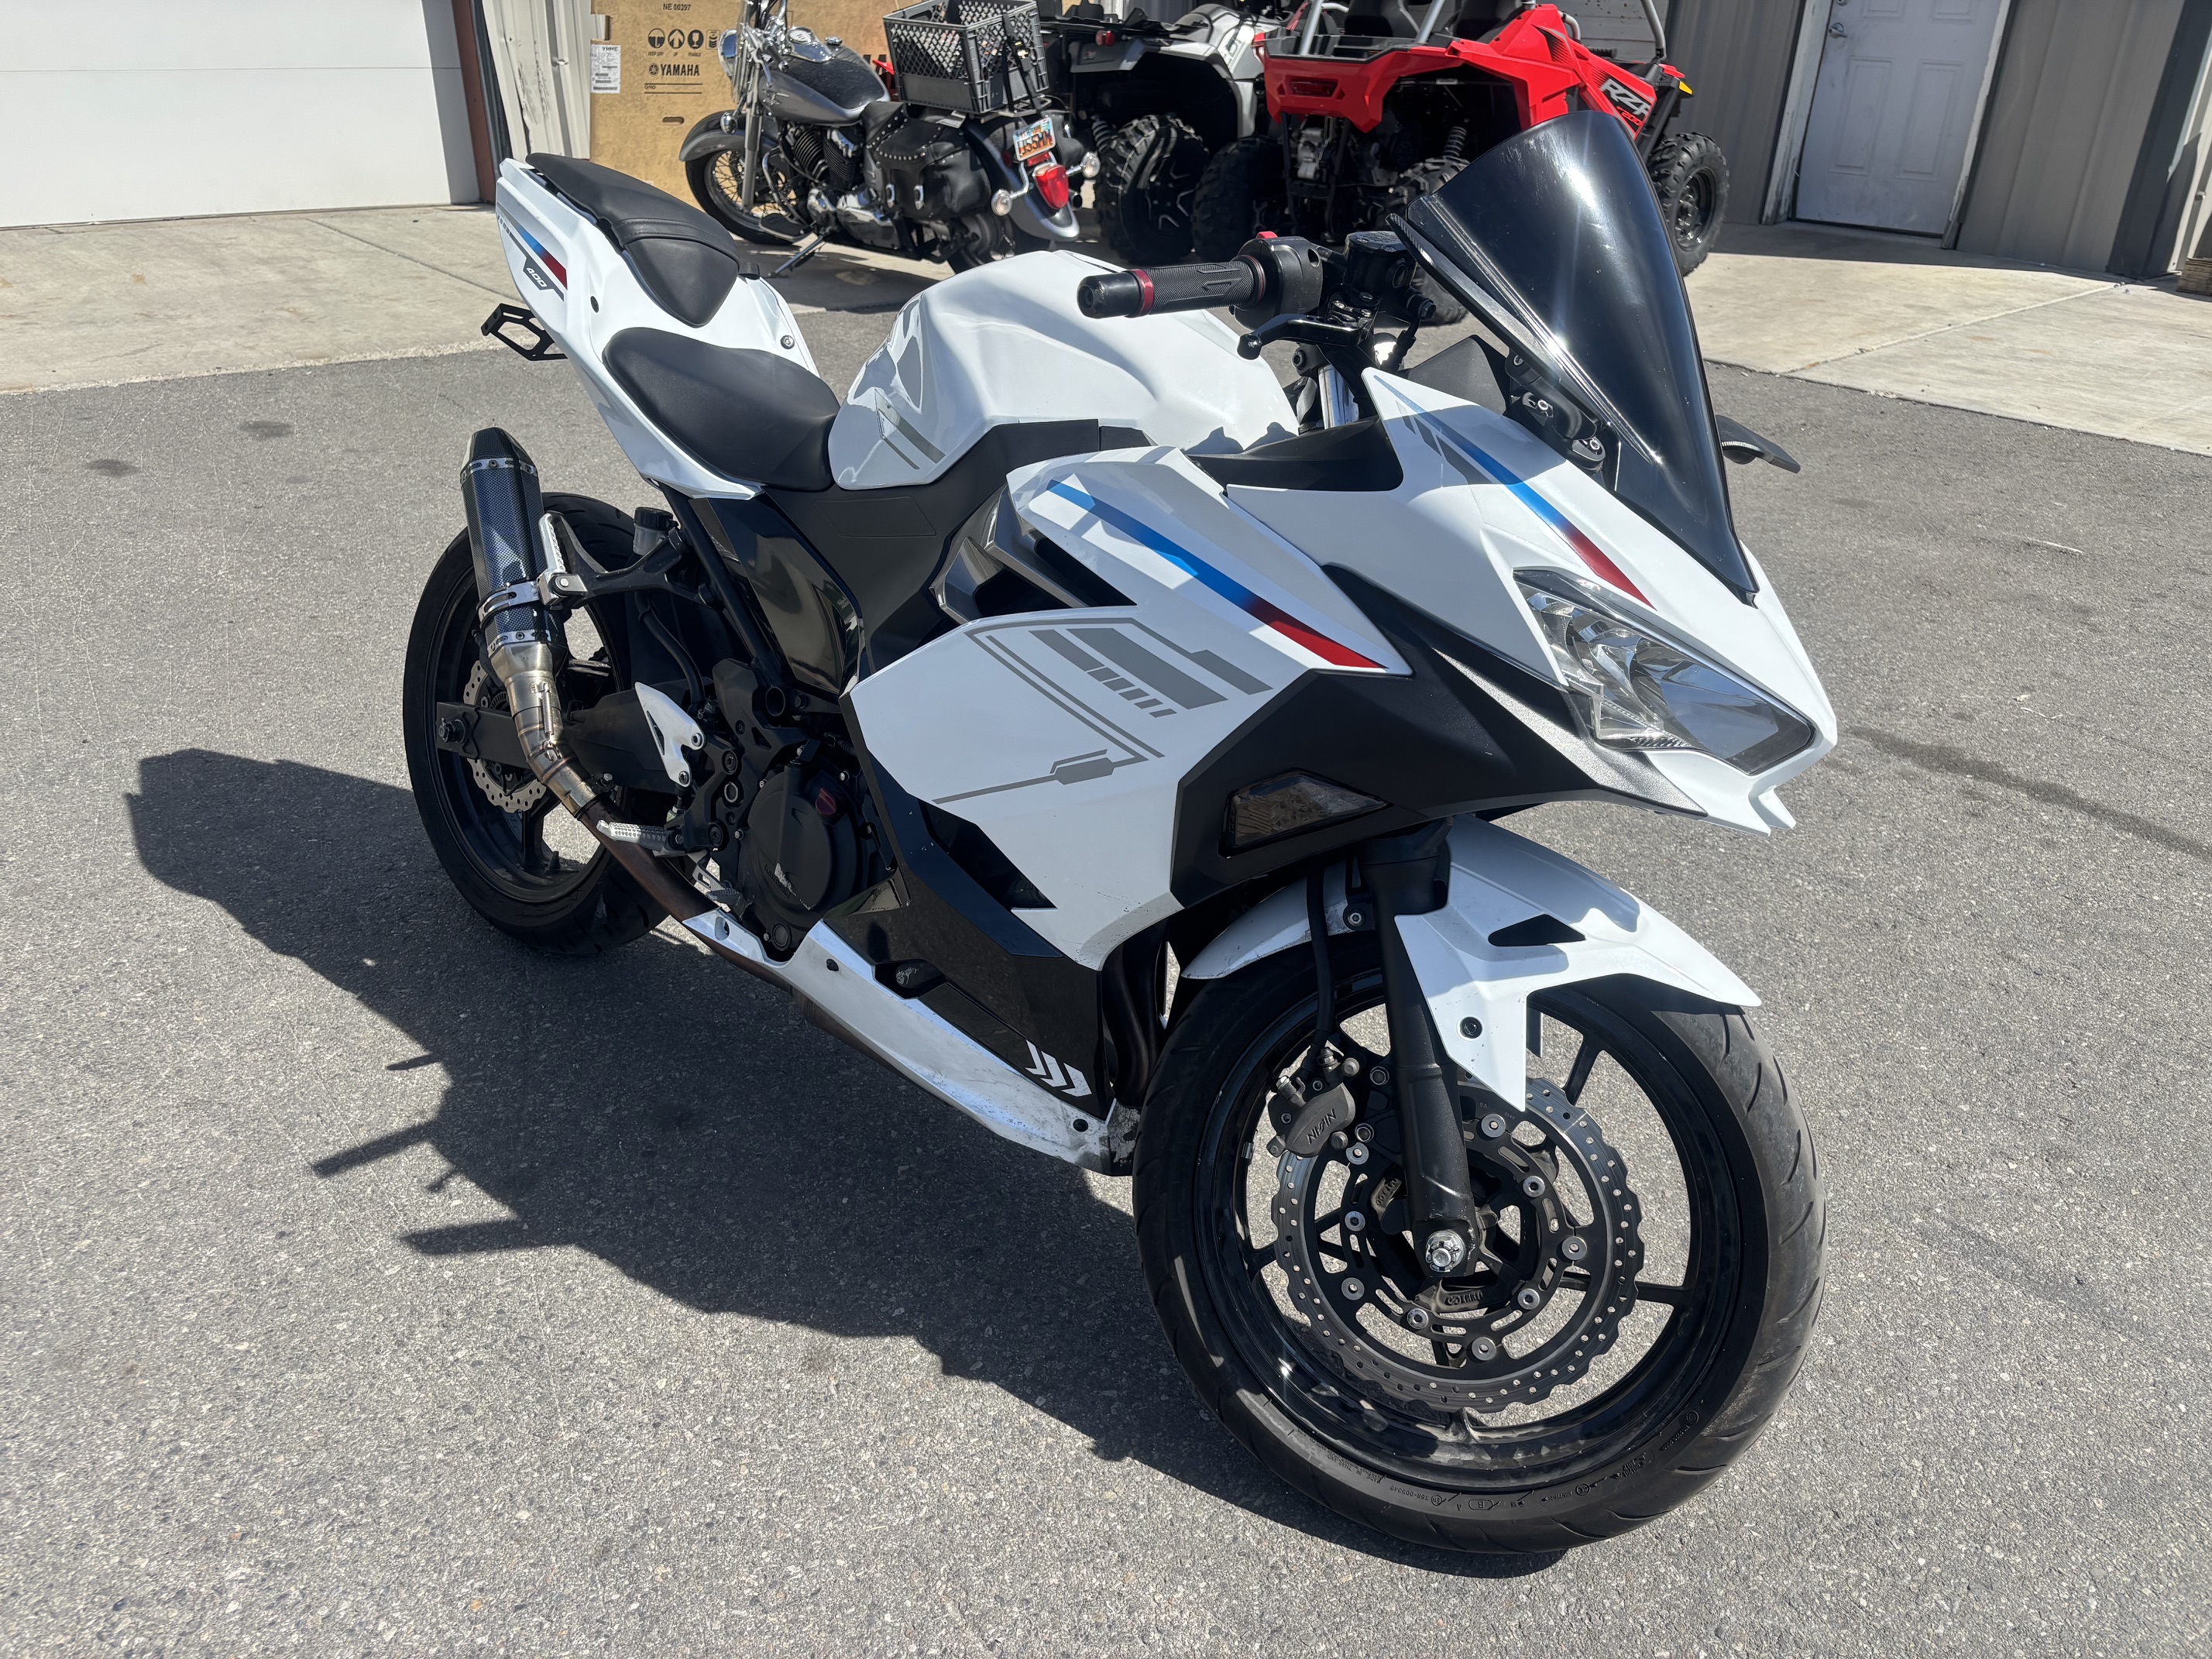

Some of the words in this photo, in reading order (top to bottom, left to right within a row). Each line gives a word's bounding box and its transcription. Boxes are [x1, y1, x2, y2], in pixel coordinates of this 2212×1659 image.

[661, 64, 700, 76] YAMAHA
[526, 267, 548, 287] 400
[1307, 1108, 1338, 1146] NISSIN
